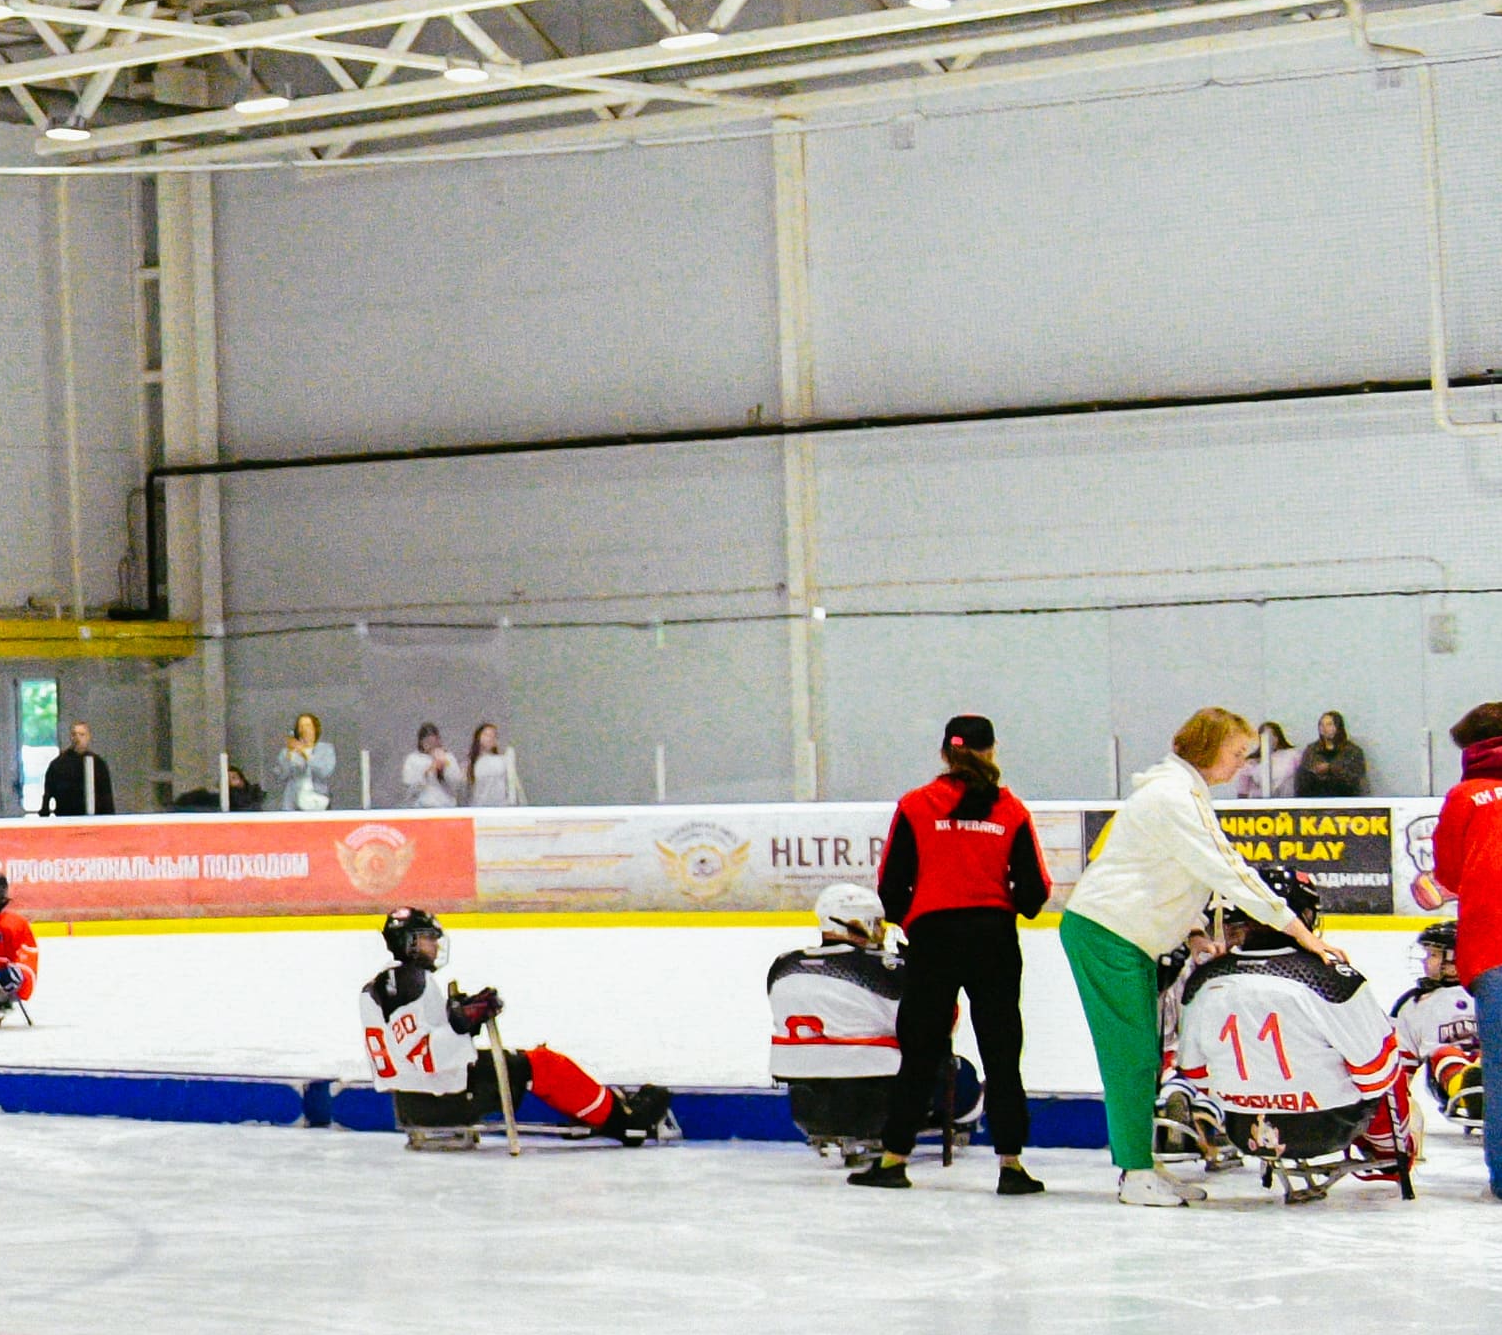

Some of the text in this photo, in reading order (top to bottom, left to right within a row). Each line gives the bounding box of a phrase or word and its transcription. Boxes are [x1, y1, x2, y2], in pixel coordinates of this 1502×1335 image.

[1220, 812, 1389, 836] ЧНОЙ КАТОК
[1278, 842, 1345, 862] PLAY
[6, 855, 200, 885] ПРОФЕССИОНАЛЬНЫМ
[202, 852, 309, 882] ПОДХОДОМ
[1218, 1011, 1293, 1081] 11
